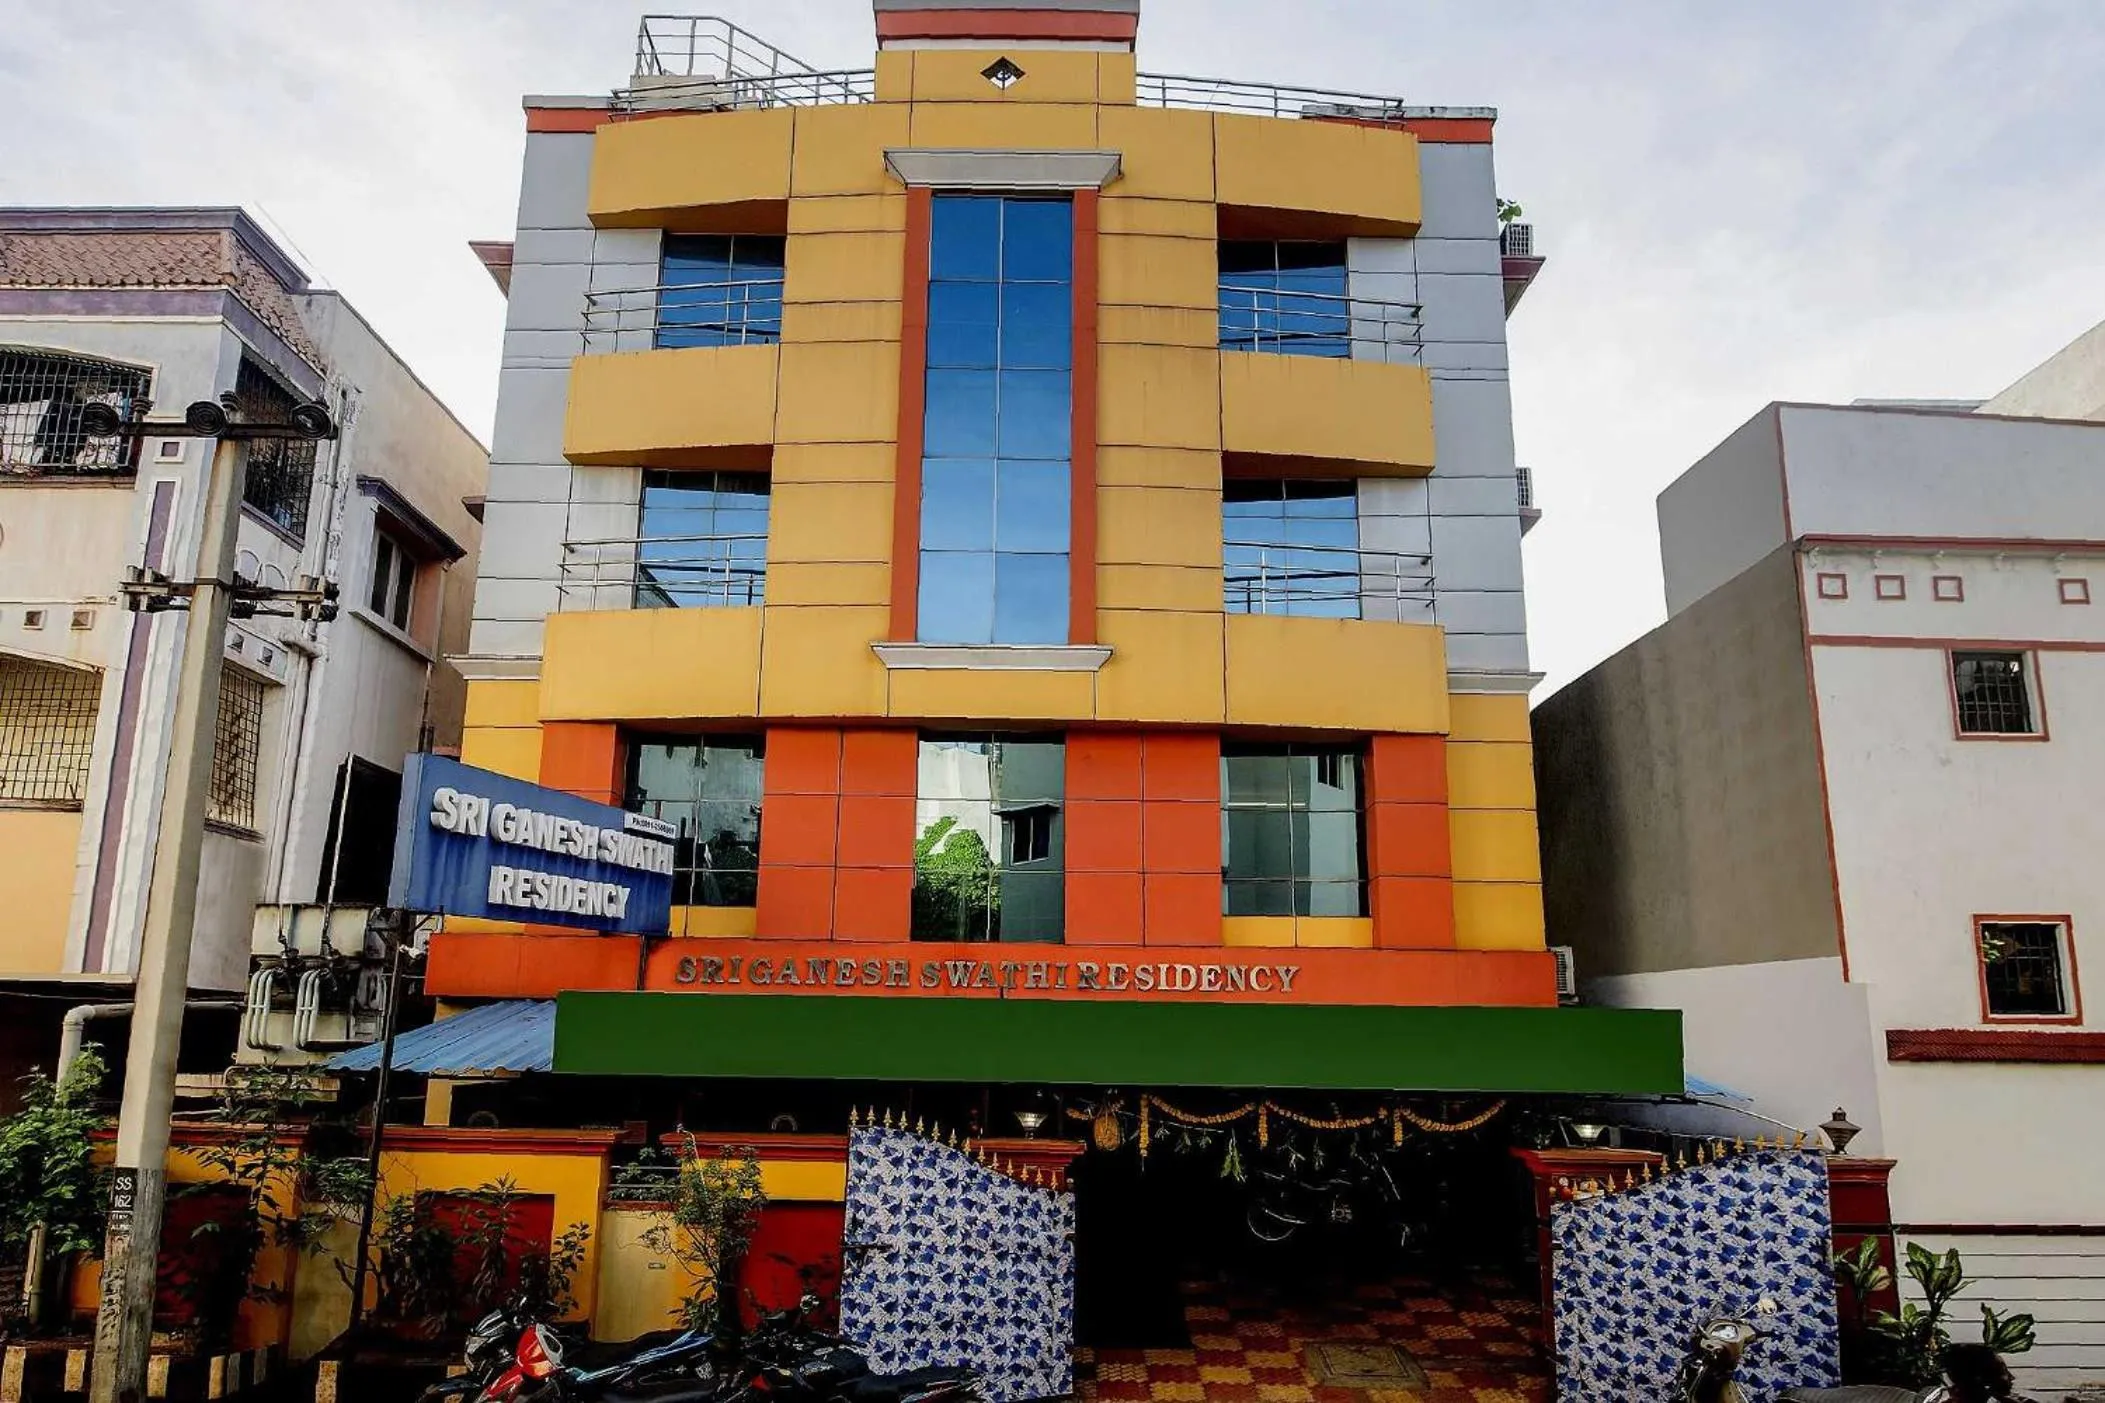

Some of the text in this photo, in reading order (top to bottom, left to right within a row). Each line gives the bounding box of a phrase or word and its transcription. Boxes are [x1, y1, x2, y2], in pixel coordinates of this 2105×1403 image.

[432, 788, 674, 875] SRI GANESH SWATHI
[488, 866, 630, 919] RESIDENCY
[675, 956, 1300, 993] SRI GANESH SWATHI RESIDENCY
[114, 1194, 132, 1208] 162
[115, 1176, 132, 1190] SS
